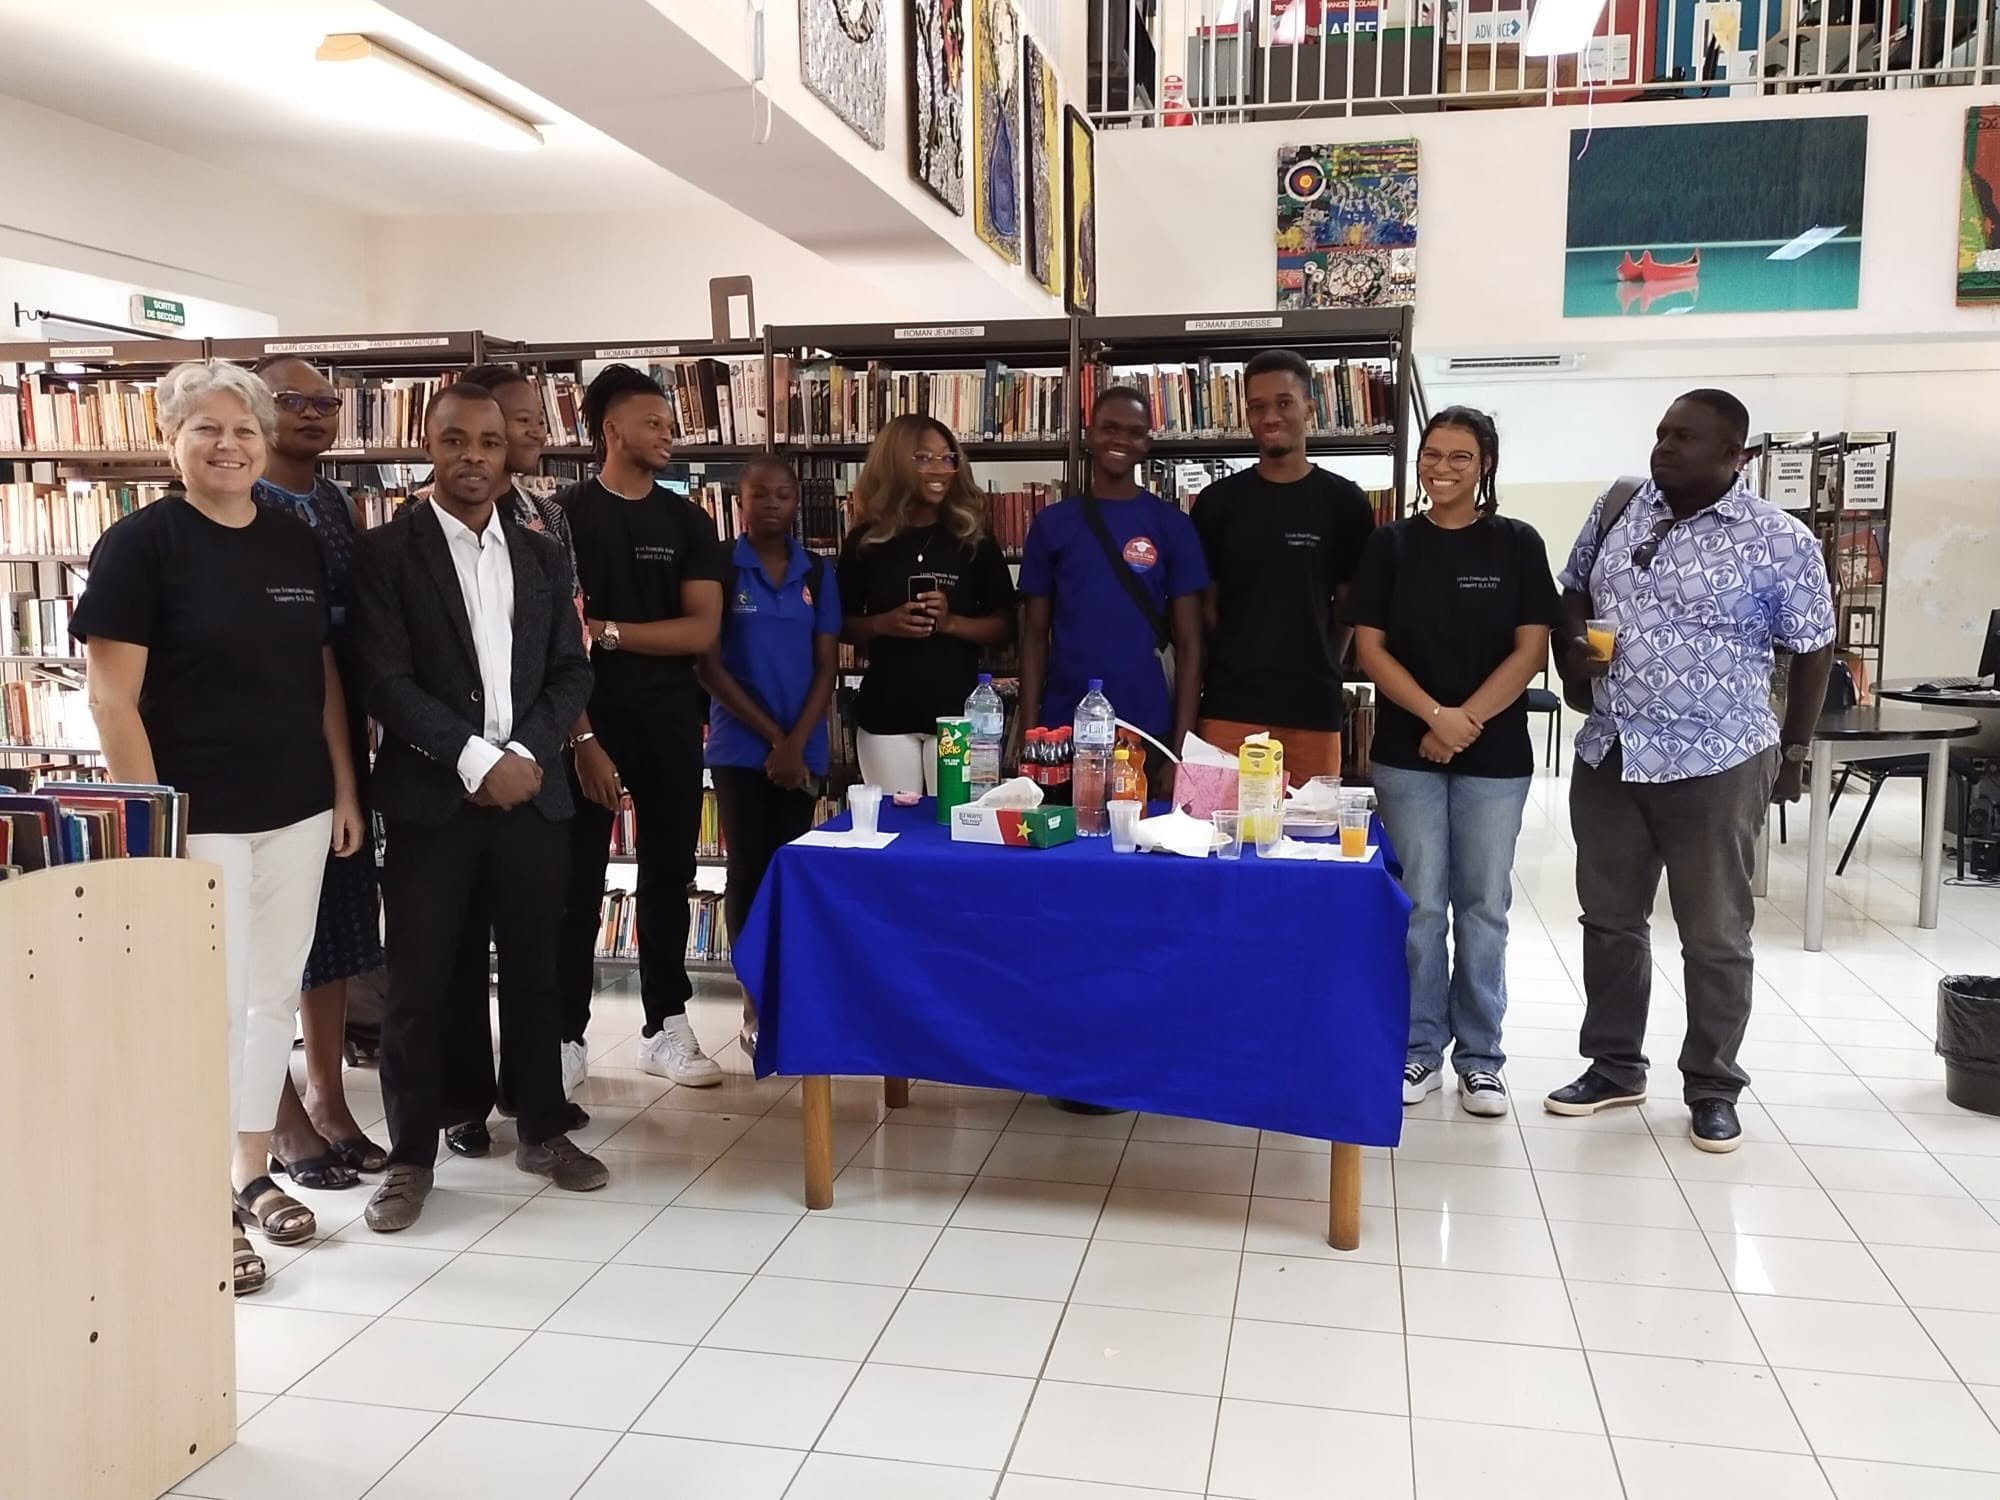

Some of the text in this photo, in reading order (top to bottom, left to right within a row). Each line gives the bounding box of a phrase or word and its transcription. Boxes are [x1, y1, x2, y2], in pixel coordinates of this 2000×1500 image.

[153, 299, 177, 312] SORTIE
[146, 309, 184, 324] DE SECOURS
[1195, 319, 1273, 329] ROMAN JEUNESSE
[903, 327, 975, 337] ROMAN JEUNESSE
[272, 344, 297, 352] ROMAN
[603, 349, 631, 357] ROMAN
